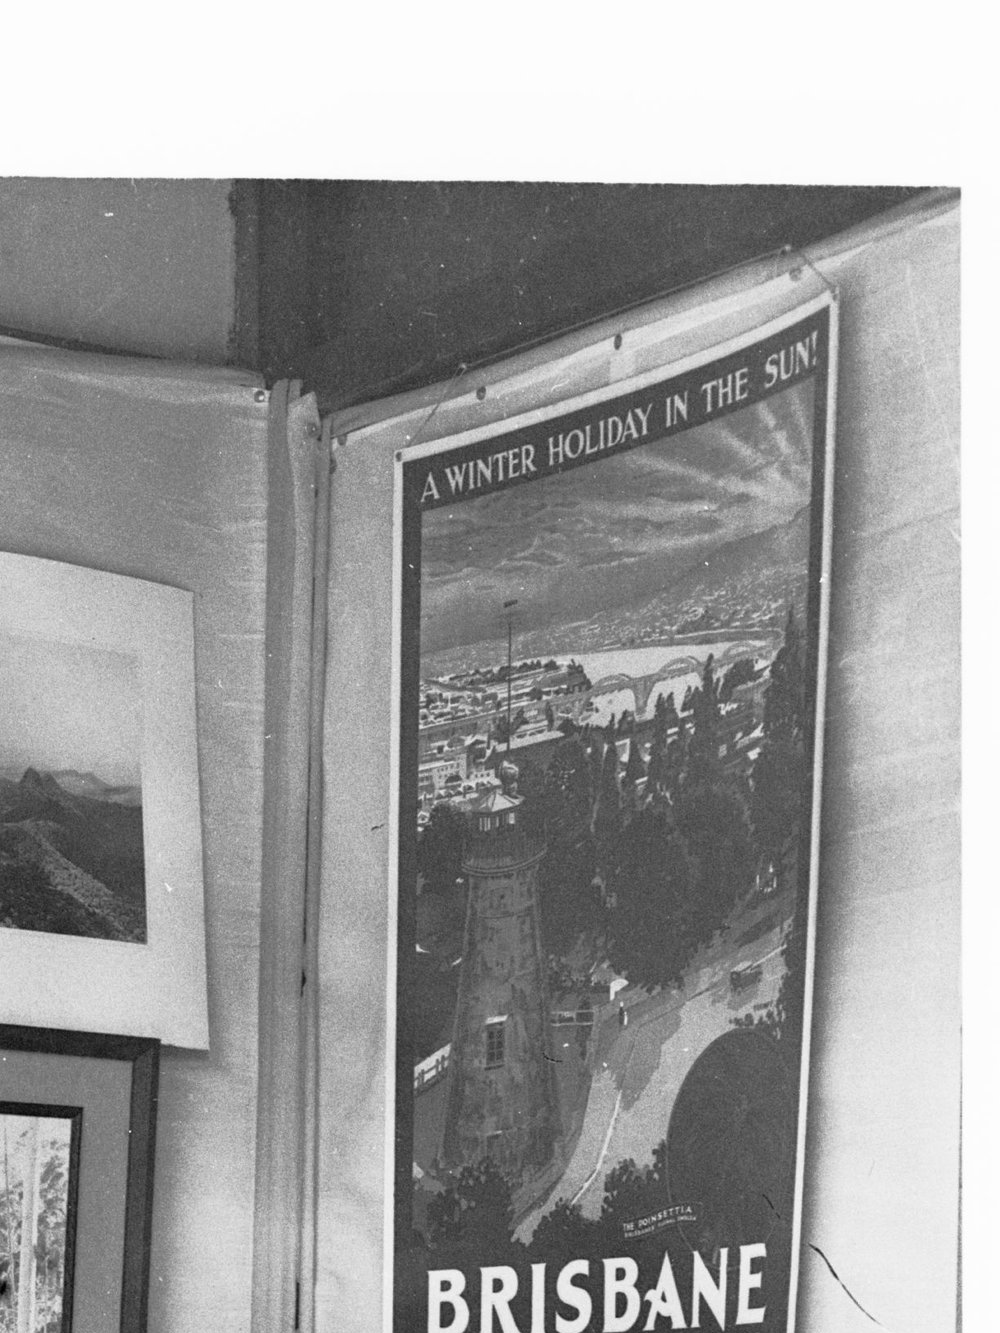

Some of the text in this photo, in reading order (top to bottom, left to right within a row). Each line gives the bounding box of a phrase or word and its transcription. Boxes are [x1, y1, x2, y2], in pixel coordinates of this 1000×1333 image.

[421, 330, 819, 502] A WINTER HOLIDAY IN THE SUN!
